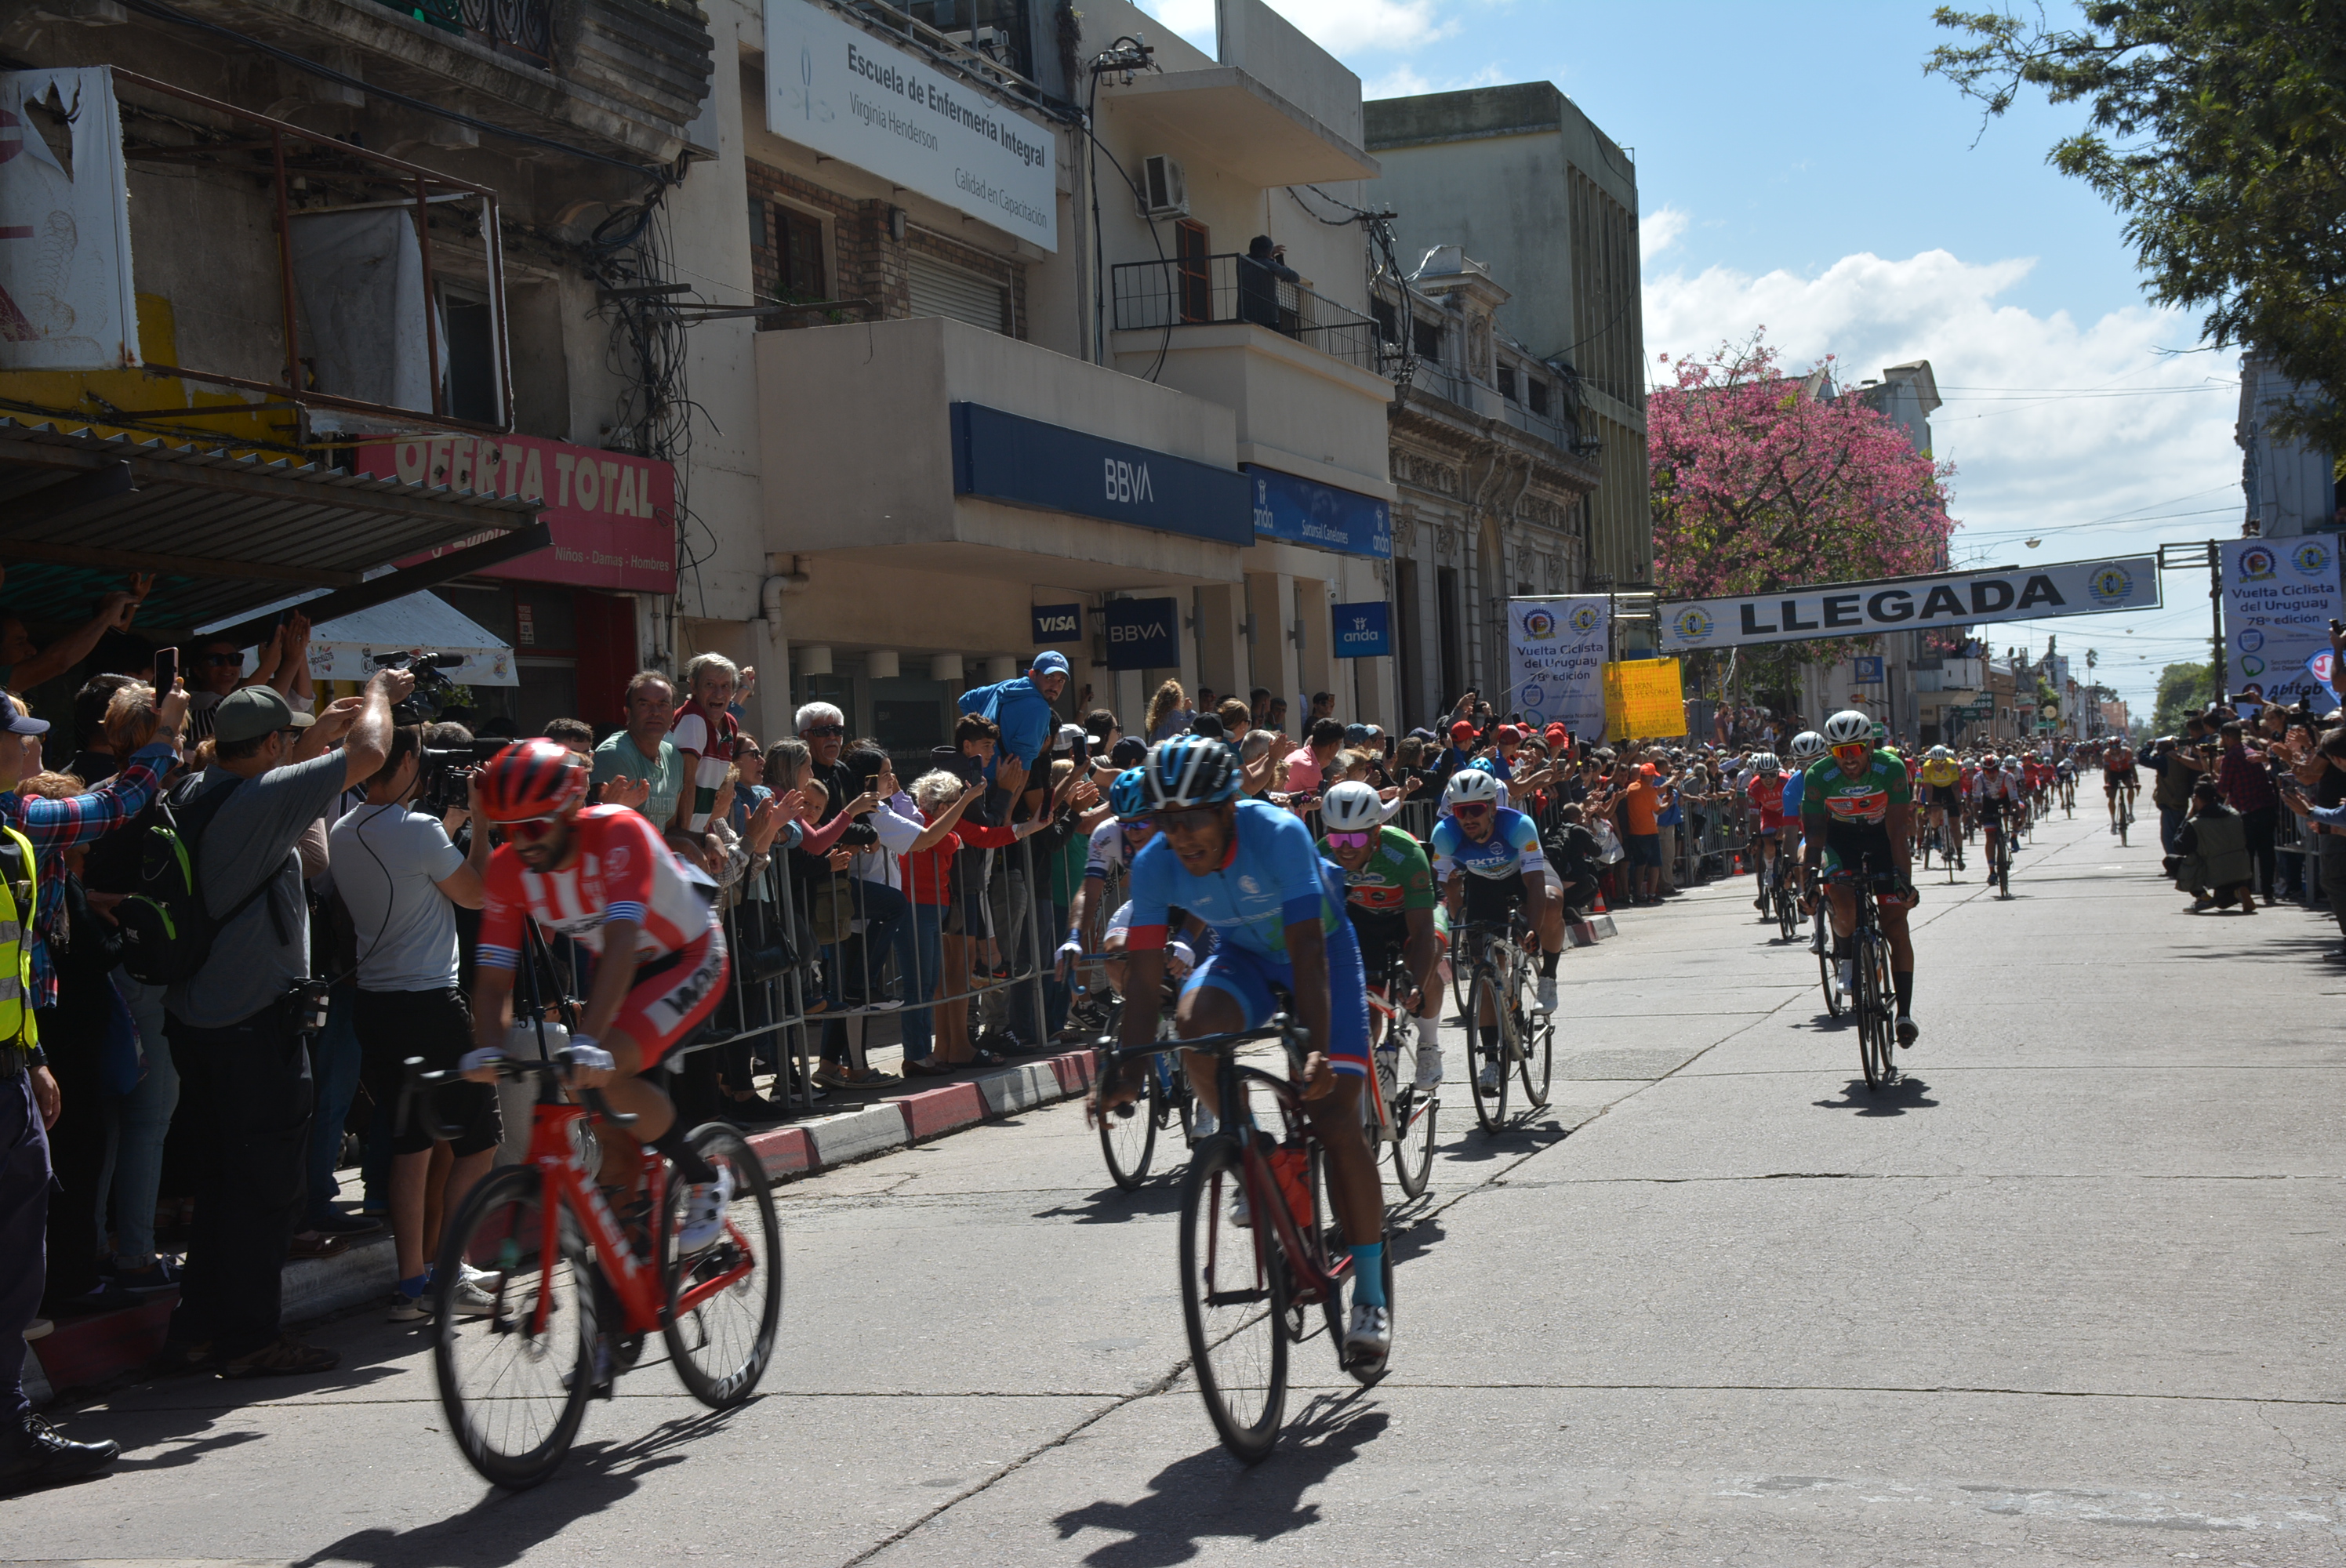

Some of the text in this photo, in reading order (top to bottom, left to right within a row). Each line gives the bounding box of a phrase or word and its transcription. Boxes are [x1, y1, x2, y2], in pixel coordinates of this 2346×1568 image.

[848, 42, 1044, 168] Escuela de Enfermería Integral
[849, 91, 939, 152] Virginia Henderson
[954, 168, 1048, 229] Calidad en Capacitación
[395, 434, 653, 518] OFERTA TOTAL
[1104, 457, 1153, 504] BBVA
[1254, 505, 1273, 529] anda
[1302, 519, 1349, 545] Sucursal Canelones
[1373, 532, 1389, 553] anda
[555, 546, 670, 572] Niños Damas Hombres
[2232, 583, 2335, 598] Vuelta Ciclista
[1739, 575, 2067, 635] LLEGADA
[2240, 597, 2328, 612] del Uruguay
[1037, 614, 1077, 632] VISA
[2275, 613, 2319, 625] edición
[1110, 622, 1166, 643] BBVA
[1344, 628, 1378, 643] anda
[1517, 642, 1603, 656] Vuelta Ciclista
[1524, 659, 1543, 669] del
[1545, 656, 1597, 669] Uruguay
[1553, 670, 1590, 681] edición
[1636, 687, 1676, 698] PERSONAS
[2268, 682, 2324, 697] Abitab
